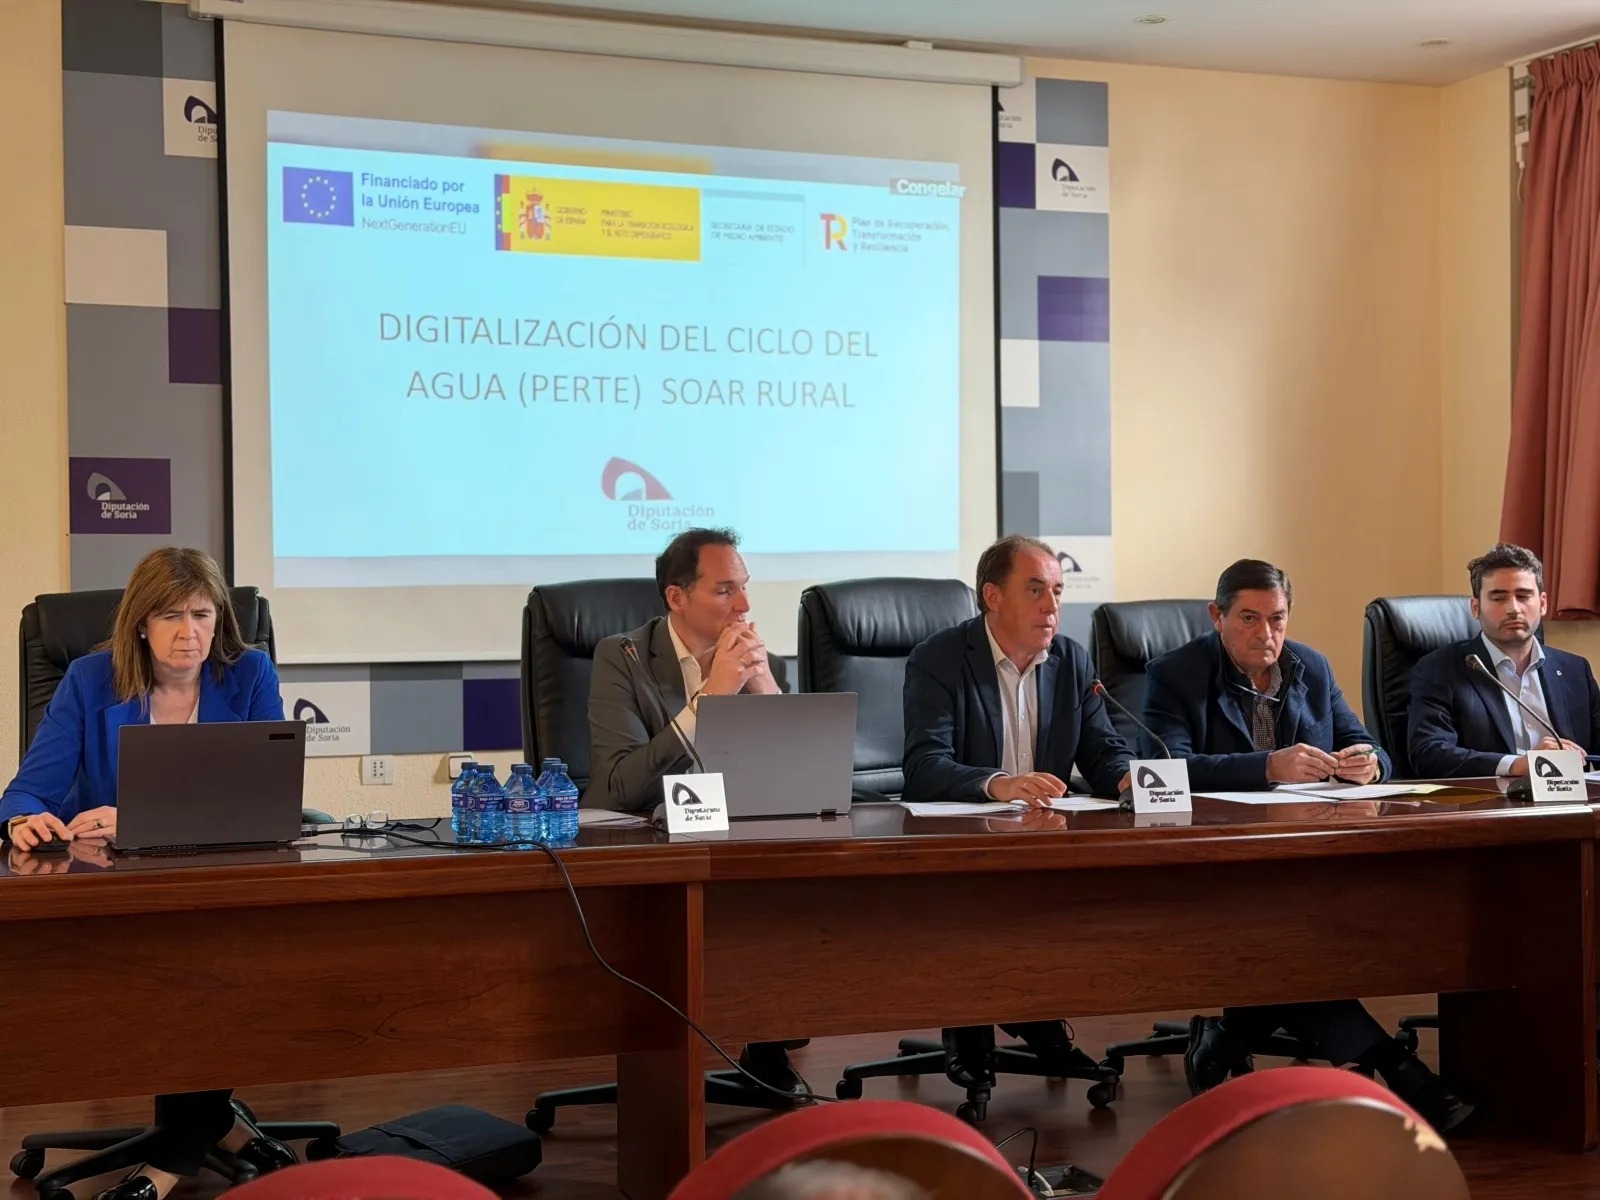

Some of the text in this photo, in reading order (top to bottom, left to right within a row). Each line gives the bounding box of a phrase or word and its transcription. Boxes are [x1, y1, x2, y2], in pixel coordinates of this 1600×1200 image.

[361, 172, 465, 195] Financiado por
[895, 179, 967, 198] Congelar
[361, 193, 480, 216] la Unión Europea
[362, 216, 467, 234] NextGenerationEU
[379, 313, 878, 357] DIGITALIZACIÓN DEL CICLO DEL
[406, 371, 856, 410] AGUA (PERTE) SOAR RURAL
[101, 502, 150, 512] Diputación
[101, 510, 138, 519] de Soria
[628, 505, 714, 520] Diputación
[627, 517, 646, 530] de
[305, 734, 340, 742] de Soria
[306, 726, 351, 735] Diputación
